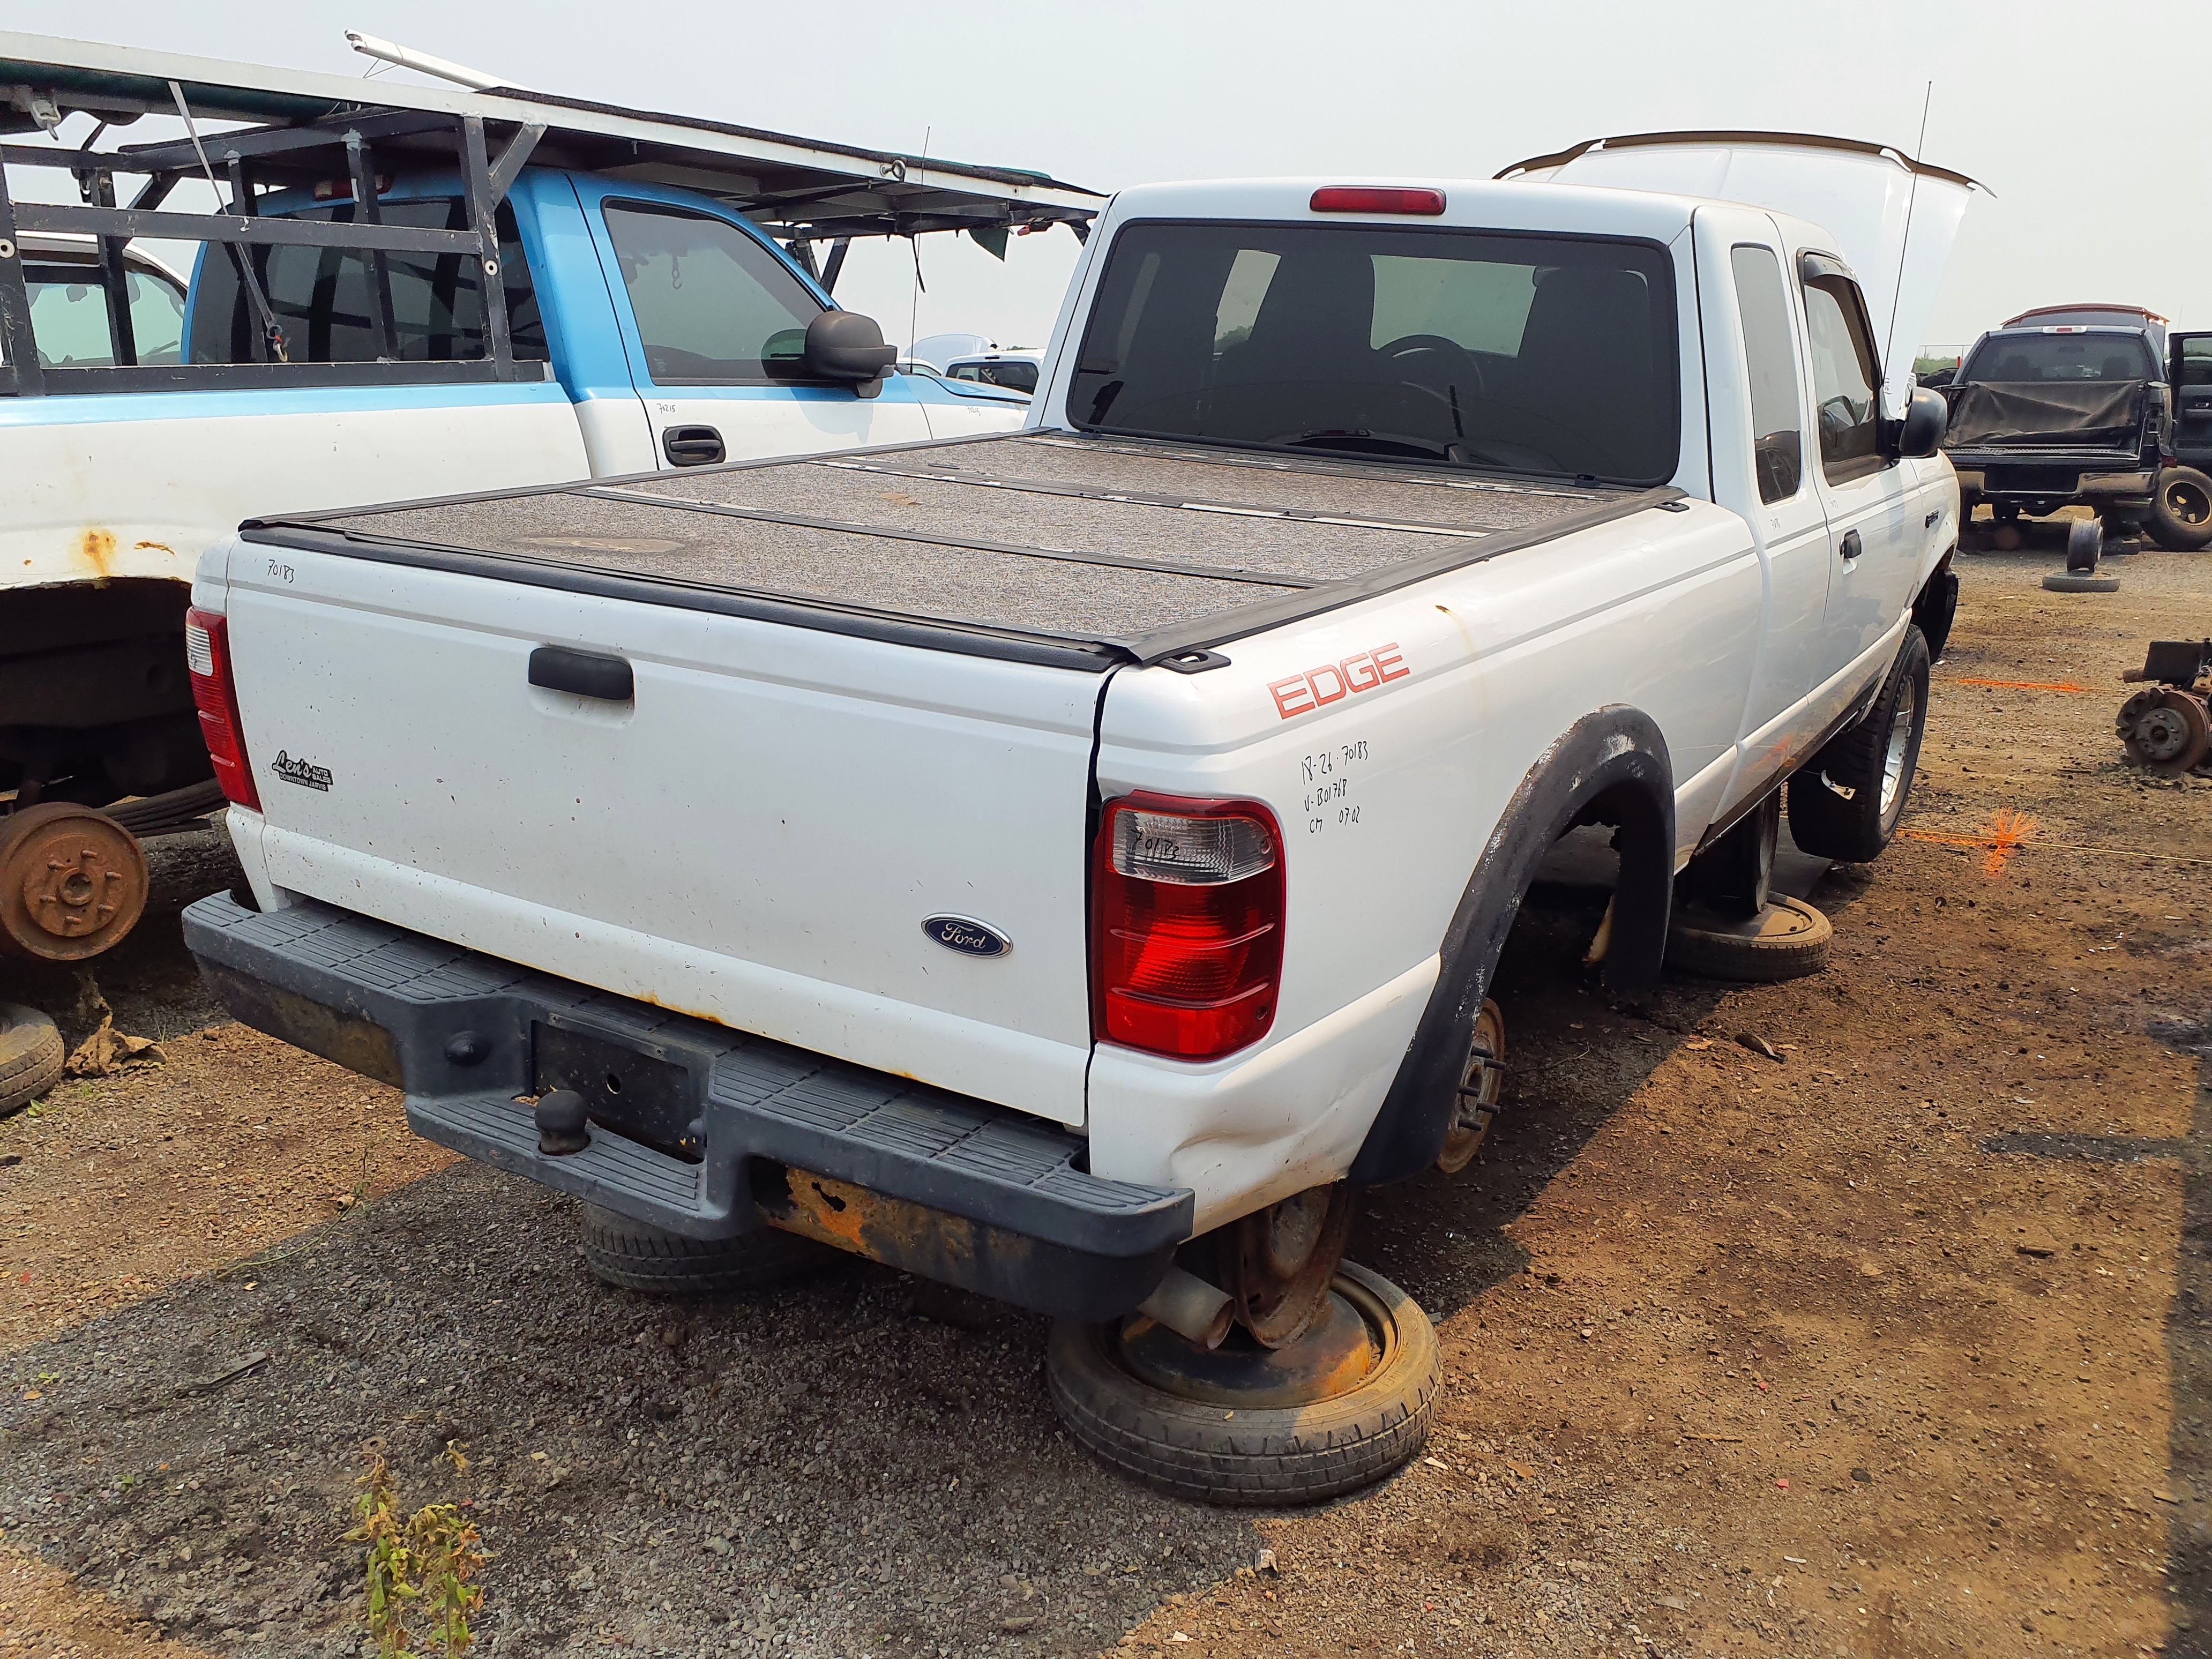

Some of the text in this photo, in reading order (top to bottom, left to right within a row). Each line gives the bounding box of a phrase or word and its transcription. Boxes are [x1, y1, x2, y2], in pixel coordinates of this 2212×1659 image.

[267, 559, 295, 583] 70183
[1266, 642, 1410, 720] EDGE
[272, 751, 312, 778] Len's
[1341, 741, 1368, 765] 70183
[279, 773, 326, 790] DOWNTOWN JARVIS
[312, 767, 328, 777] AUTO
[312, 773, 331, 783] SALES
[941, 922, 987, 949] Ford
